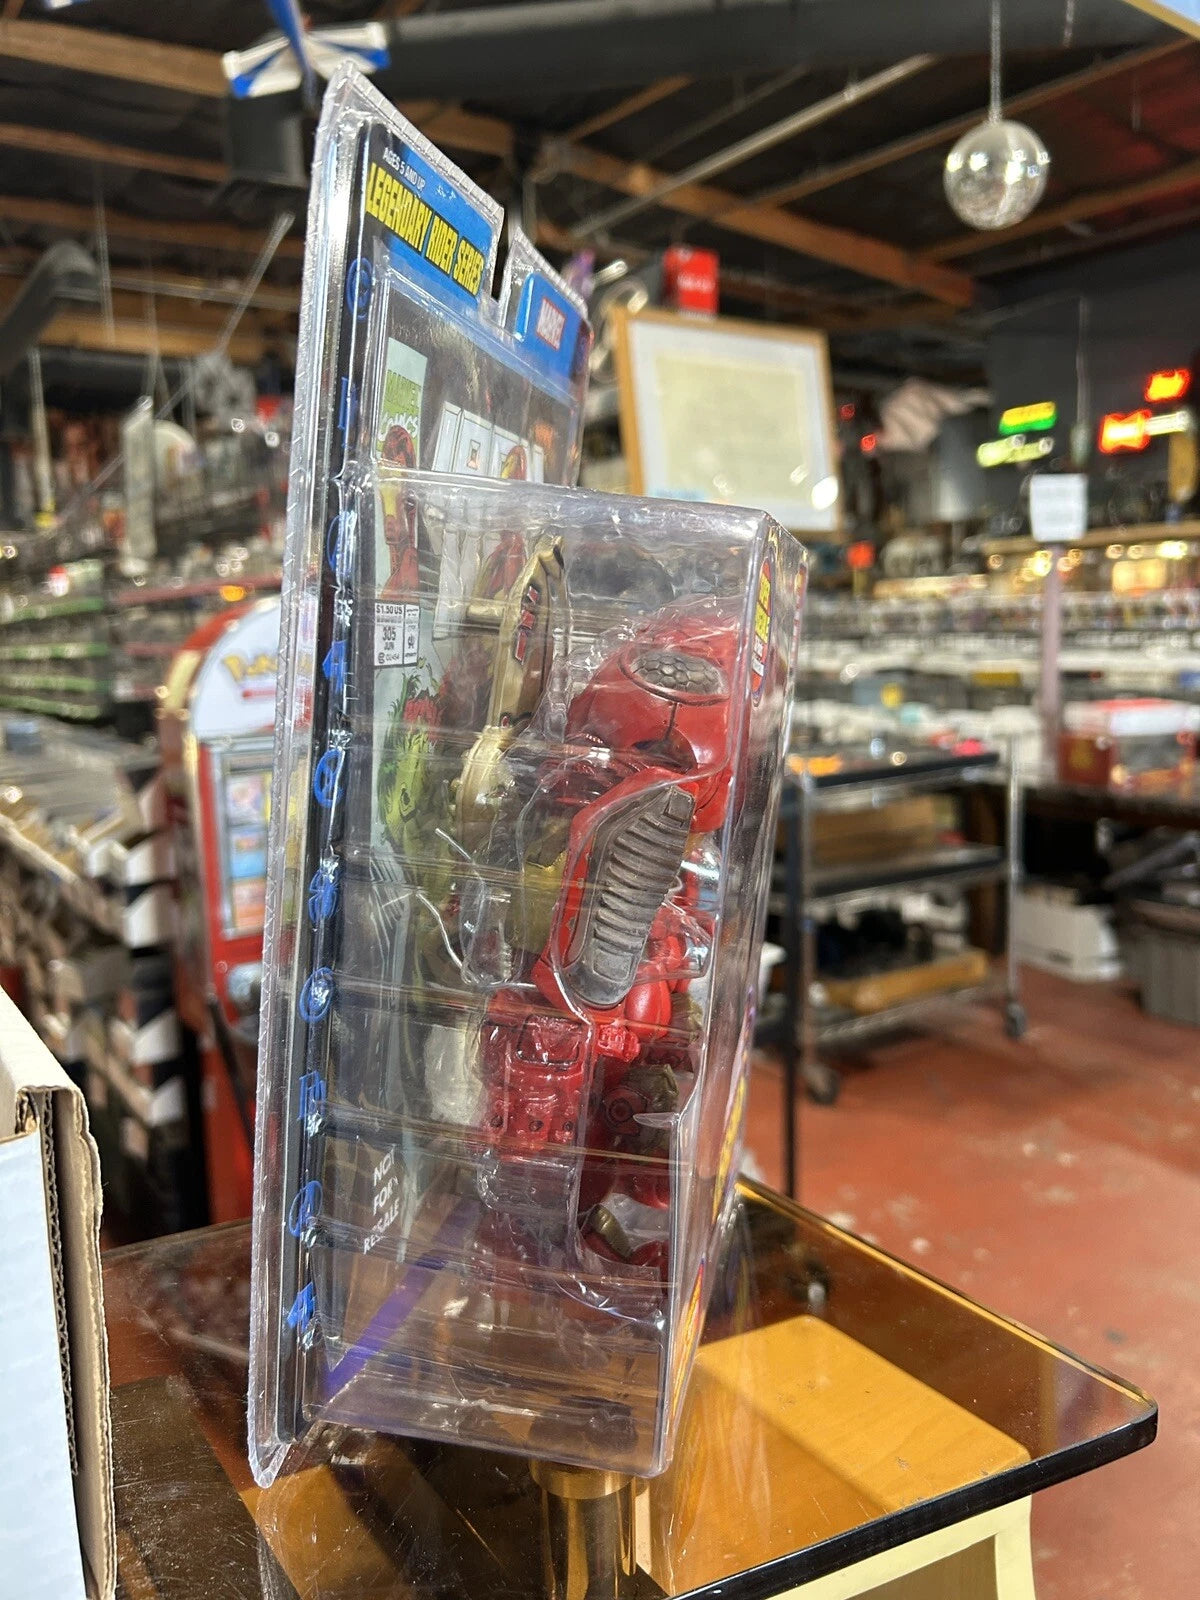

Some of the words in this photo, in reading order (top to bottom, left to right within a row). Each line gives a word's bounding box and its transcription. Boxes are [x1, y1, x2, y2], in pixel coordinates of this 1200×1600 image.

[383, 147, 400, 171] AGES
[399, 161, 406, 175] 5
[404, 165, 418, 186] AND
[416, 176, 426, 191] UP
[366, 162, 432, 252] LEGENDARY
[425, 214, 459, 275] RIDER
[453, 236, 485, 296] SERIES
[376, 604, 394, 614] $1.50
[394, 607, 403, 615] US
[373, 1143, 396, 1187] NOT
[373, 1176, 399, 1216] FOR
[363, 1197, 400, 1255] RESALE
